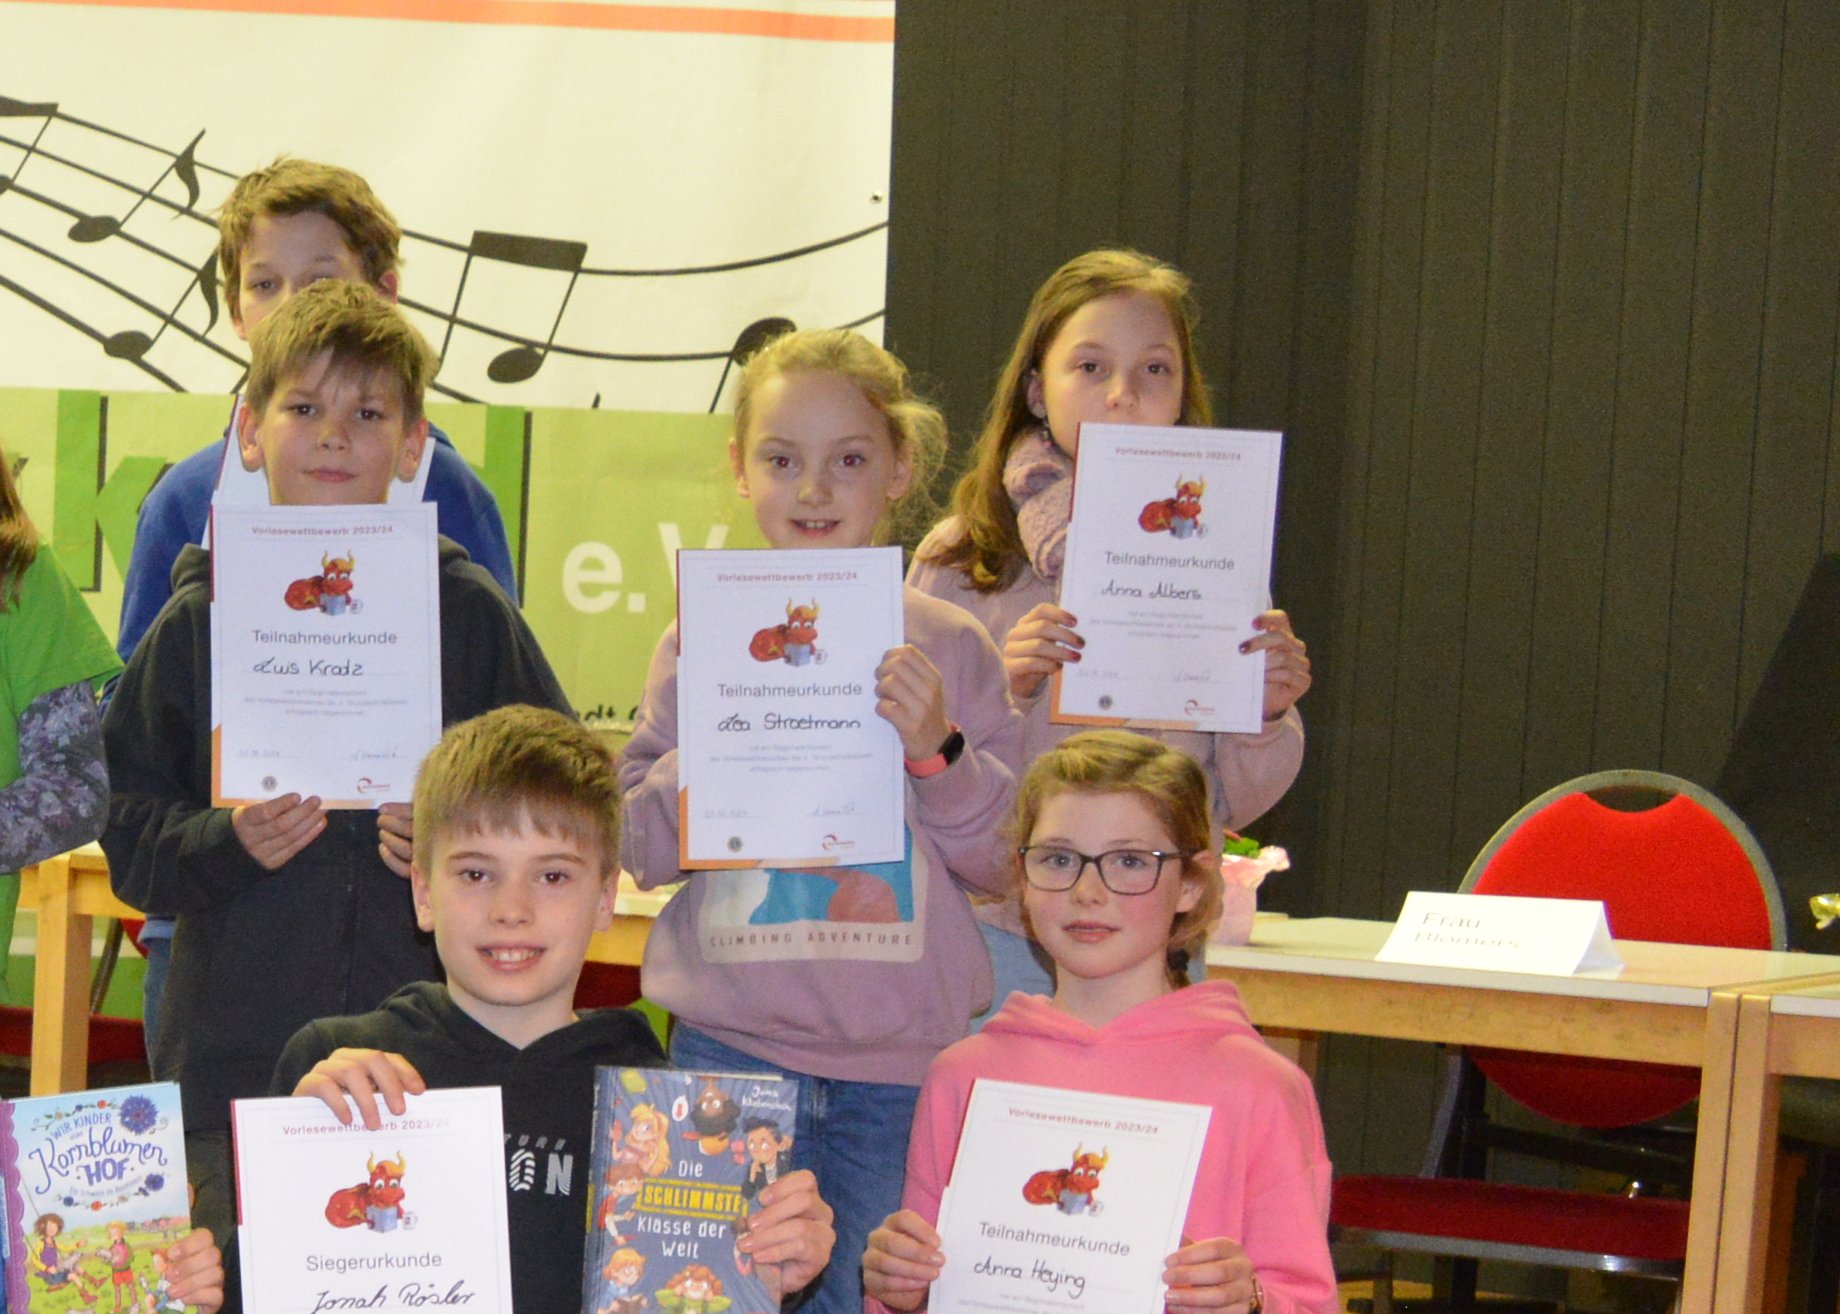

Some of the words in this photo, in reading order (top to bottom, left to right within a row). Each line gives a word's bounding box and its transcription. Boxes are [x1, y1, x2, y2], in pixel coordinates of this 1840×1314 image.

[251, 526, 350, 536] Vorlesewettbewerb
[352, 525, 394, 535] 2023/24
[1104, 550, 1235, 571] Teilnahmeurkunde
[715, 571, 814, 584] Vorlesewettbewerb
[816, 571, 858, 582] 2023/24
[1101, 580, 1143, 598] Anna
[1148, 581, 1202, 600] Albers
[252, 630, 398, 646] Teilnahmeurkunde
[717, 682, 863, 698] Teilnahmeurkunde
[1421, 911, 1481, 929] Frau
[708, 931, 793, 949] CLIMBING
[806, 931, 913, 947] ADVENTURE
[51, 1122, 72, 1141] WIR
[74, 1112, 113, 1129] KINDER
[282, 1119, 398, 1136] Vorlesewettbeerb
[1007, 1106, 1112, 1130] Vorlesewettbewerb
[1114, 1121, 1159, 1135] 2023/24
[28, 1126, 168, 1195] Kornblumen
[678, 1159, 704, 1178] Die
[76, 1156, 131, 1187] HOF
[644, 1184, 742, 1214] SCHLIMMSTE
[637, 1216, 691, 1236] Klasse
[698, 1217, 727, 1239] der
[978, 1221, 1131, 1258] Teilnahmeurkunde
[661, 1241, 700, 1260] Welt
[305, 1252, 443, 1273] Siegerurkunde
[972, 1254, 1023, 1280] Anna
[1030, 1258, 1087, 1300] Heying
[397, 1279, 476, 1308] Rösler
